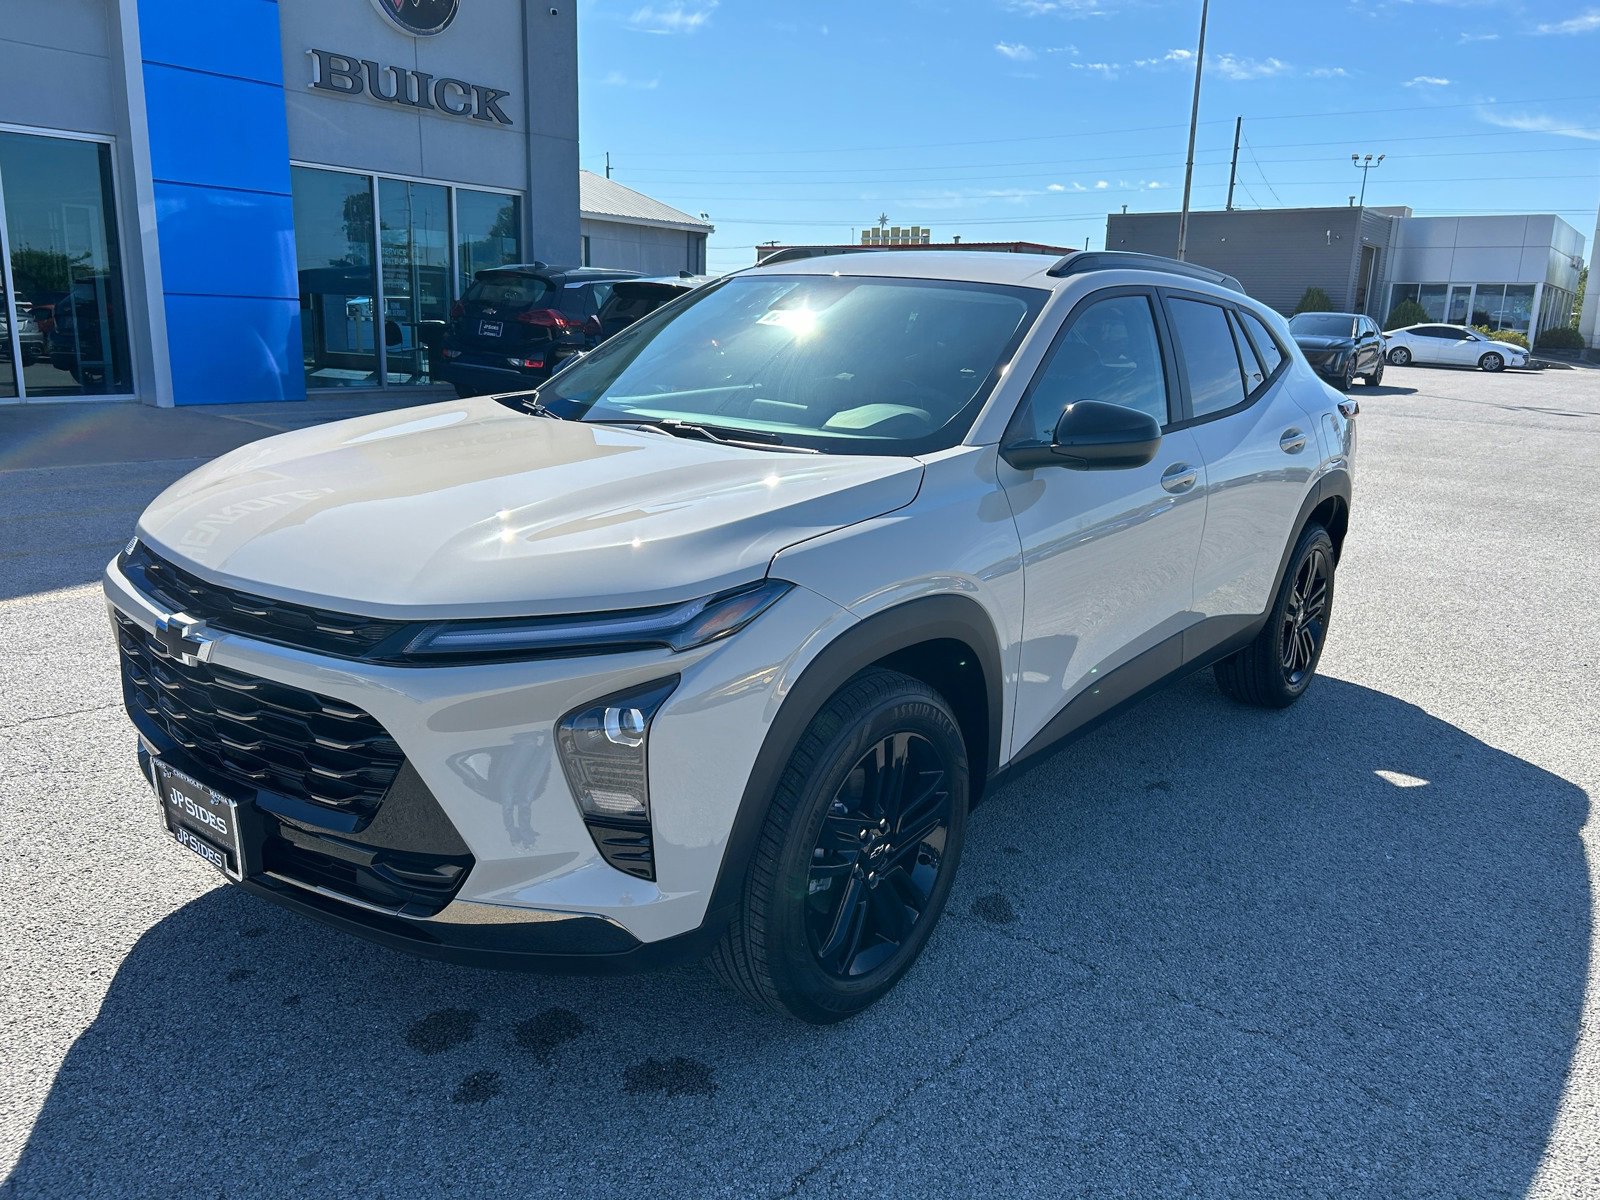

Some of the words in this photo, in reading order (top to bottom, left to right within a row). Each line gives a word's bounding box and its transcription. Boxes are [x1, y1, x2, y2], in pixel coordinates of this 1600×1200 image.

[306, 48, 513, 125] BUICK
[893, 703, 956, 737] ASSURANCE
[184, 796, 228, 835] SIDES
[189, 837, 223, 867] SIDES
